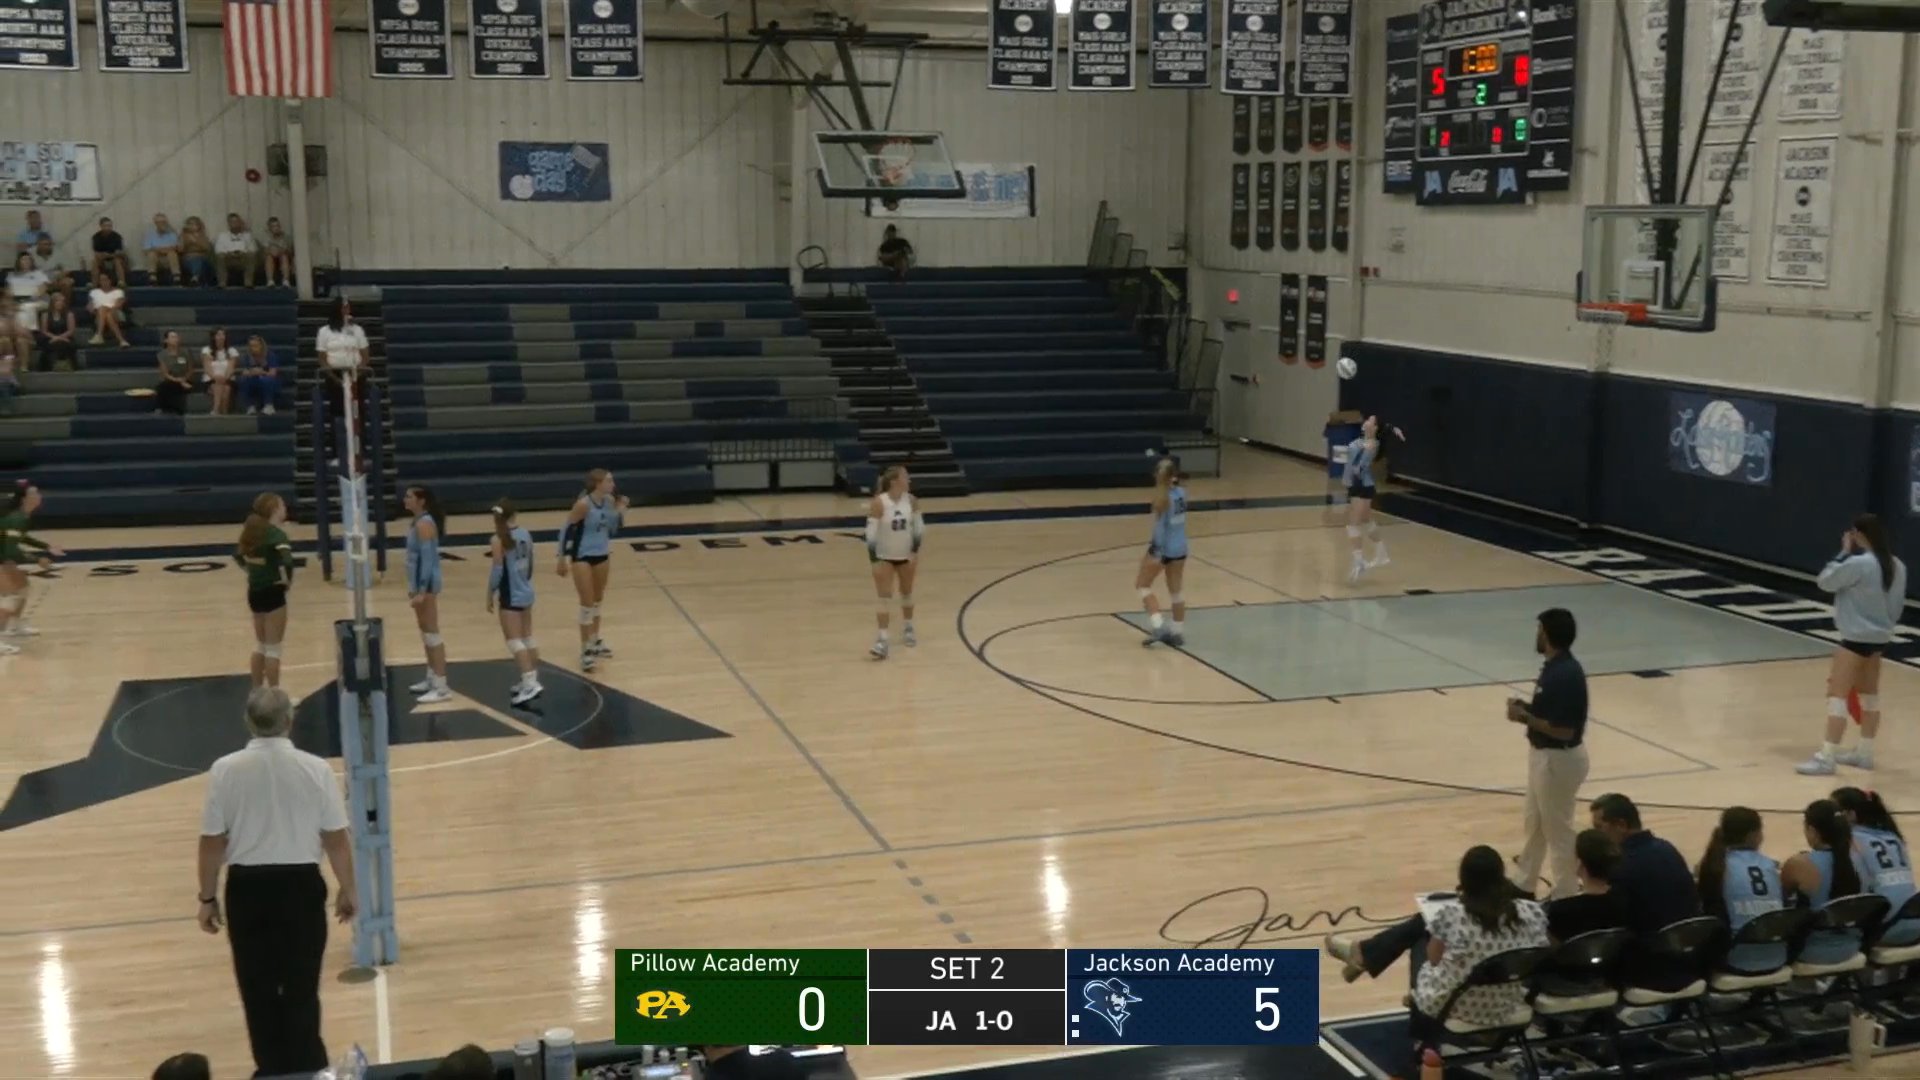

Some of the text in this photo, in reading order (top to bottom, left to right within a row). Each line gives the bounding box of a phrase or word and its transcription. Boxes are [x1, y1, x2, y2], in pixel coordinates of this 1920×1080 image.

[1444, 13, 1506, 37] ACADEMY
[1432, 66, 1446, 95] 5
[1475, 83, 1487, 105] 2
[1786, 147, 1830, 162] JACKSON
[1784, 166, 1828, 180] ACADEMY
[1748, 866, 1768, 896] 8
